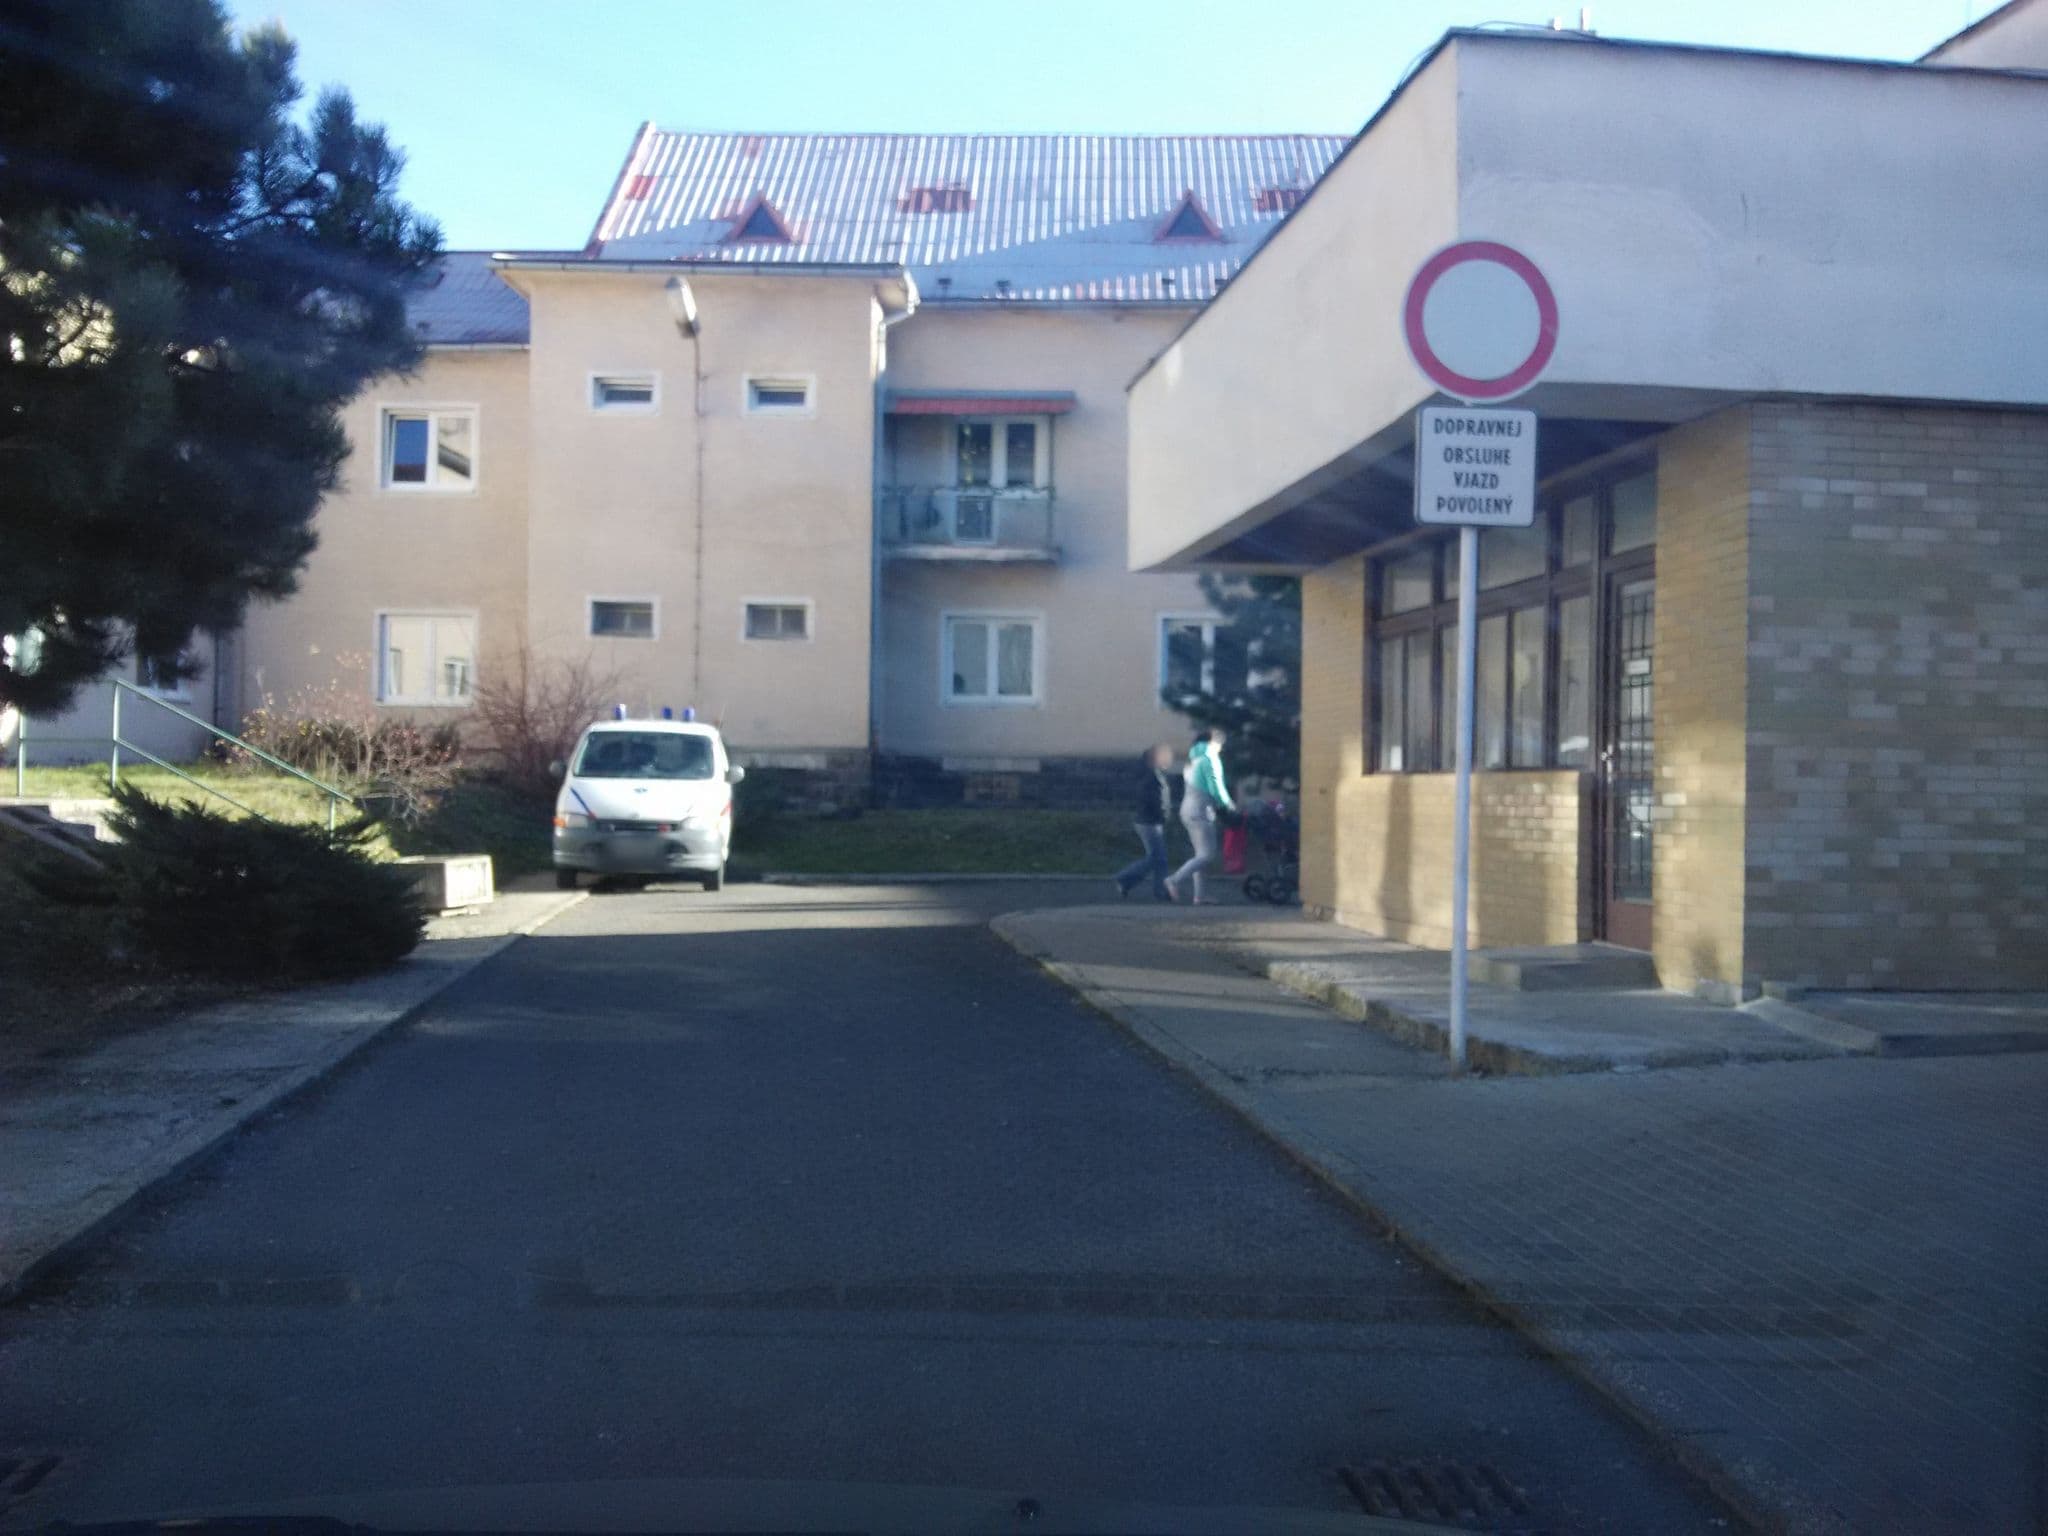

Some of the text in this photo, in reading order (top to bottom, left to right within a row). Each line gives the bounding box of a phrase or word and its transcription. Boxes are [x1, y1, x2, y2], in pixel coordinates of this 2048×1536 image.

[1434, 418, 1522, 438] DOPRAVNEJ
[1443, 447, 1511, 465] OBSLUHE
[1454, 471, 1499, 489] VJAZD
[1437, 495, 1513, 514] POVOLENÝ
